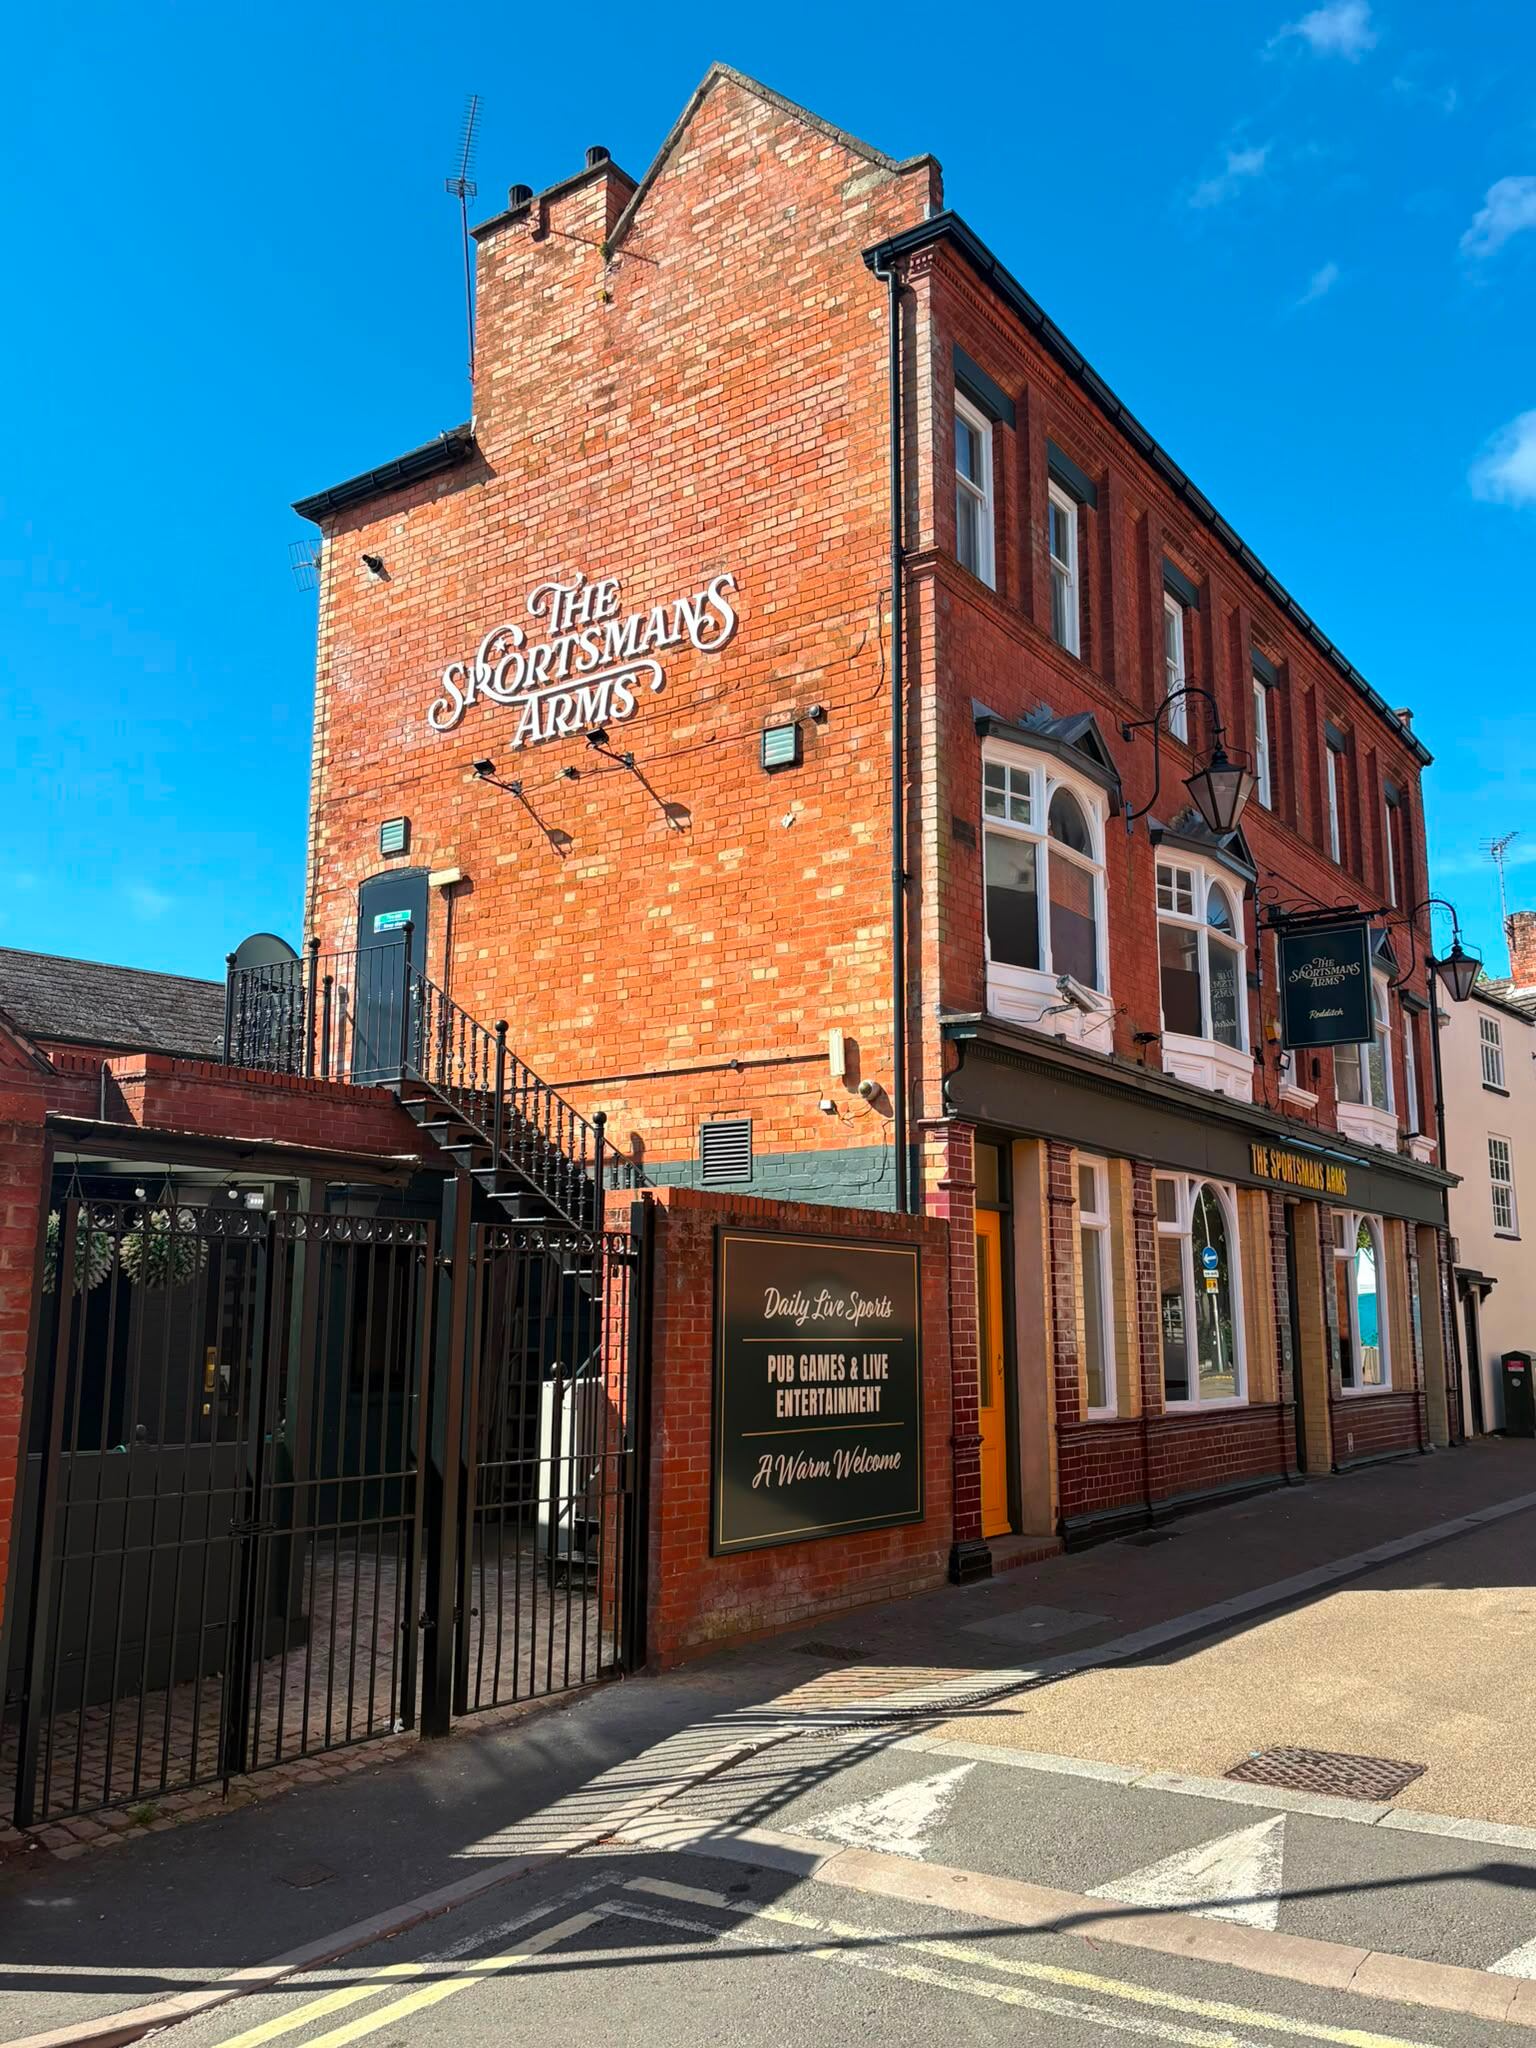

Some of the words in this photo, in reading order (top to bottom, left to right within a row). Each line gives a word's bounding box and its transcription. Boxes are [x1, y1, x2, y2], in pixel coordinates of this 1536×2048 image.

[527, 572, 620, 634] THE
[428, 573, 736, 729] SPORTSMANS
[510, 673, 638, 748] ARMS
[1310, 975, 1340, 987] ARMS
[1312, 957, 1335, 968] THE
[1309, 1008, 1344, 1020] Redditch
[1251, 1143, 1269, 1177] THE
[1270, 1149, 1325, 1191] SPORTSMANS
[1325, 1165, 1347, 1196] ARMS
[764, 1287, 810, 1326] Daily
[811, 1289, 844, 1320] Live
[845, 1291, 893, 1327] Sports
[767, 1354, 794, 1383] PUB
[799, 1354, 846, 1382] GAMES
[850, 1356, 858, 1380] &
[863, 1354, 888, 1380] LIVE
[776, 1386, 881, 1418] ENTERTAINMENT
[752, 1454, 772, 1489] A
[775, 1450, 830, 1486] Warm
[833, 1445, 901, 1480] Welcome
